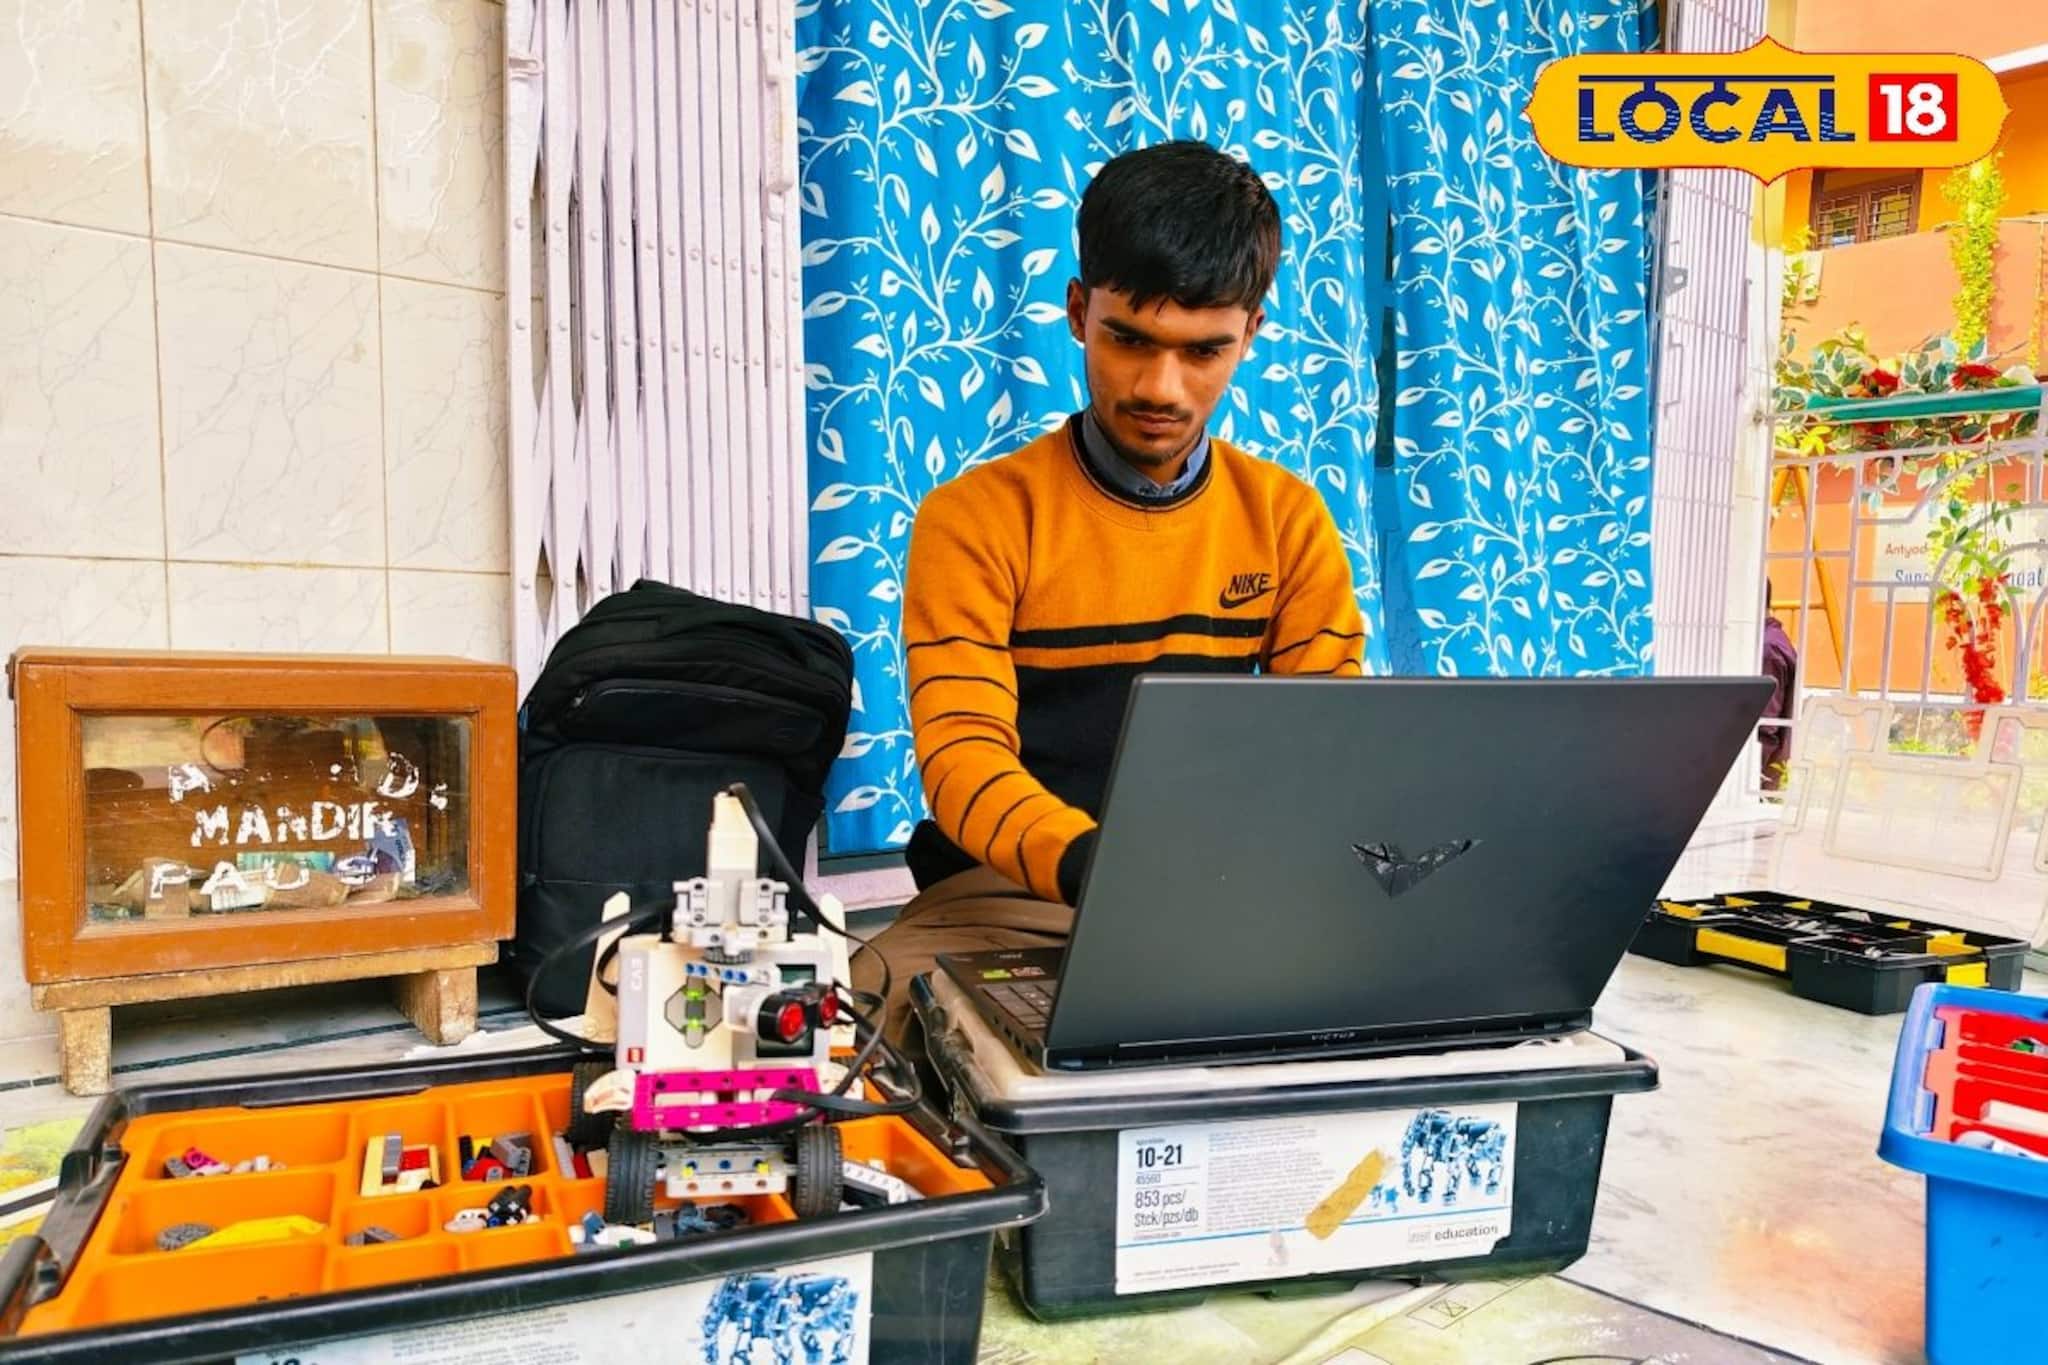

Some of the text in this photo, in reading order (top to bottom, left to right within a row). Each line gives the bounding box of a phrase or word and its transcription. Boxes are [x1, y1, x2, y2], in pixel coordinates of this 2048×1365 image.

[1885, 543, 1929, 559] Antyod
[1227, 573, 1271, 594] NIKE
[191, 800, 397, 847] MANDIR
[1136, 1144, 1183, 1168] 10-21
[1135, 1190, 1160, 1209] 853
[1434, 1224, 1499, 1241] education
